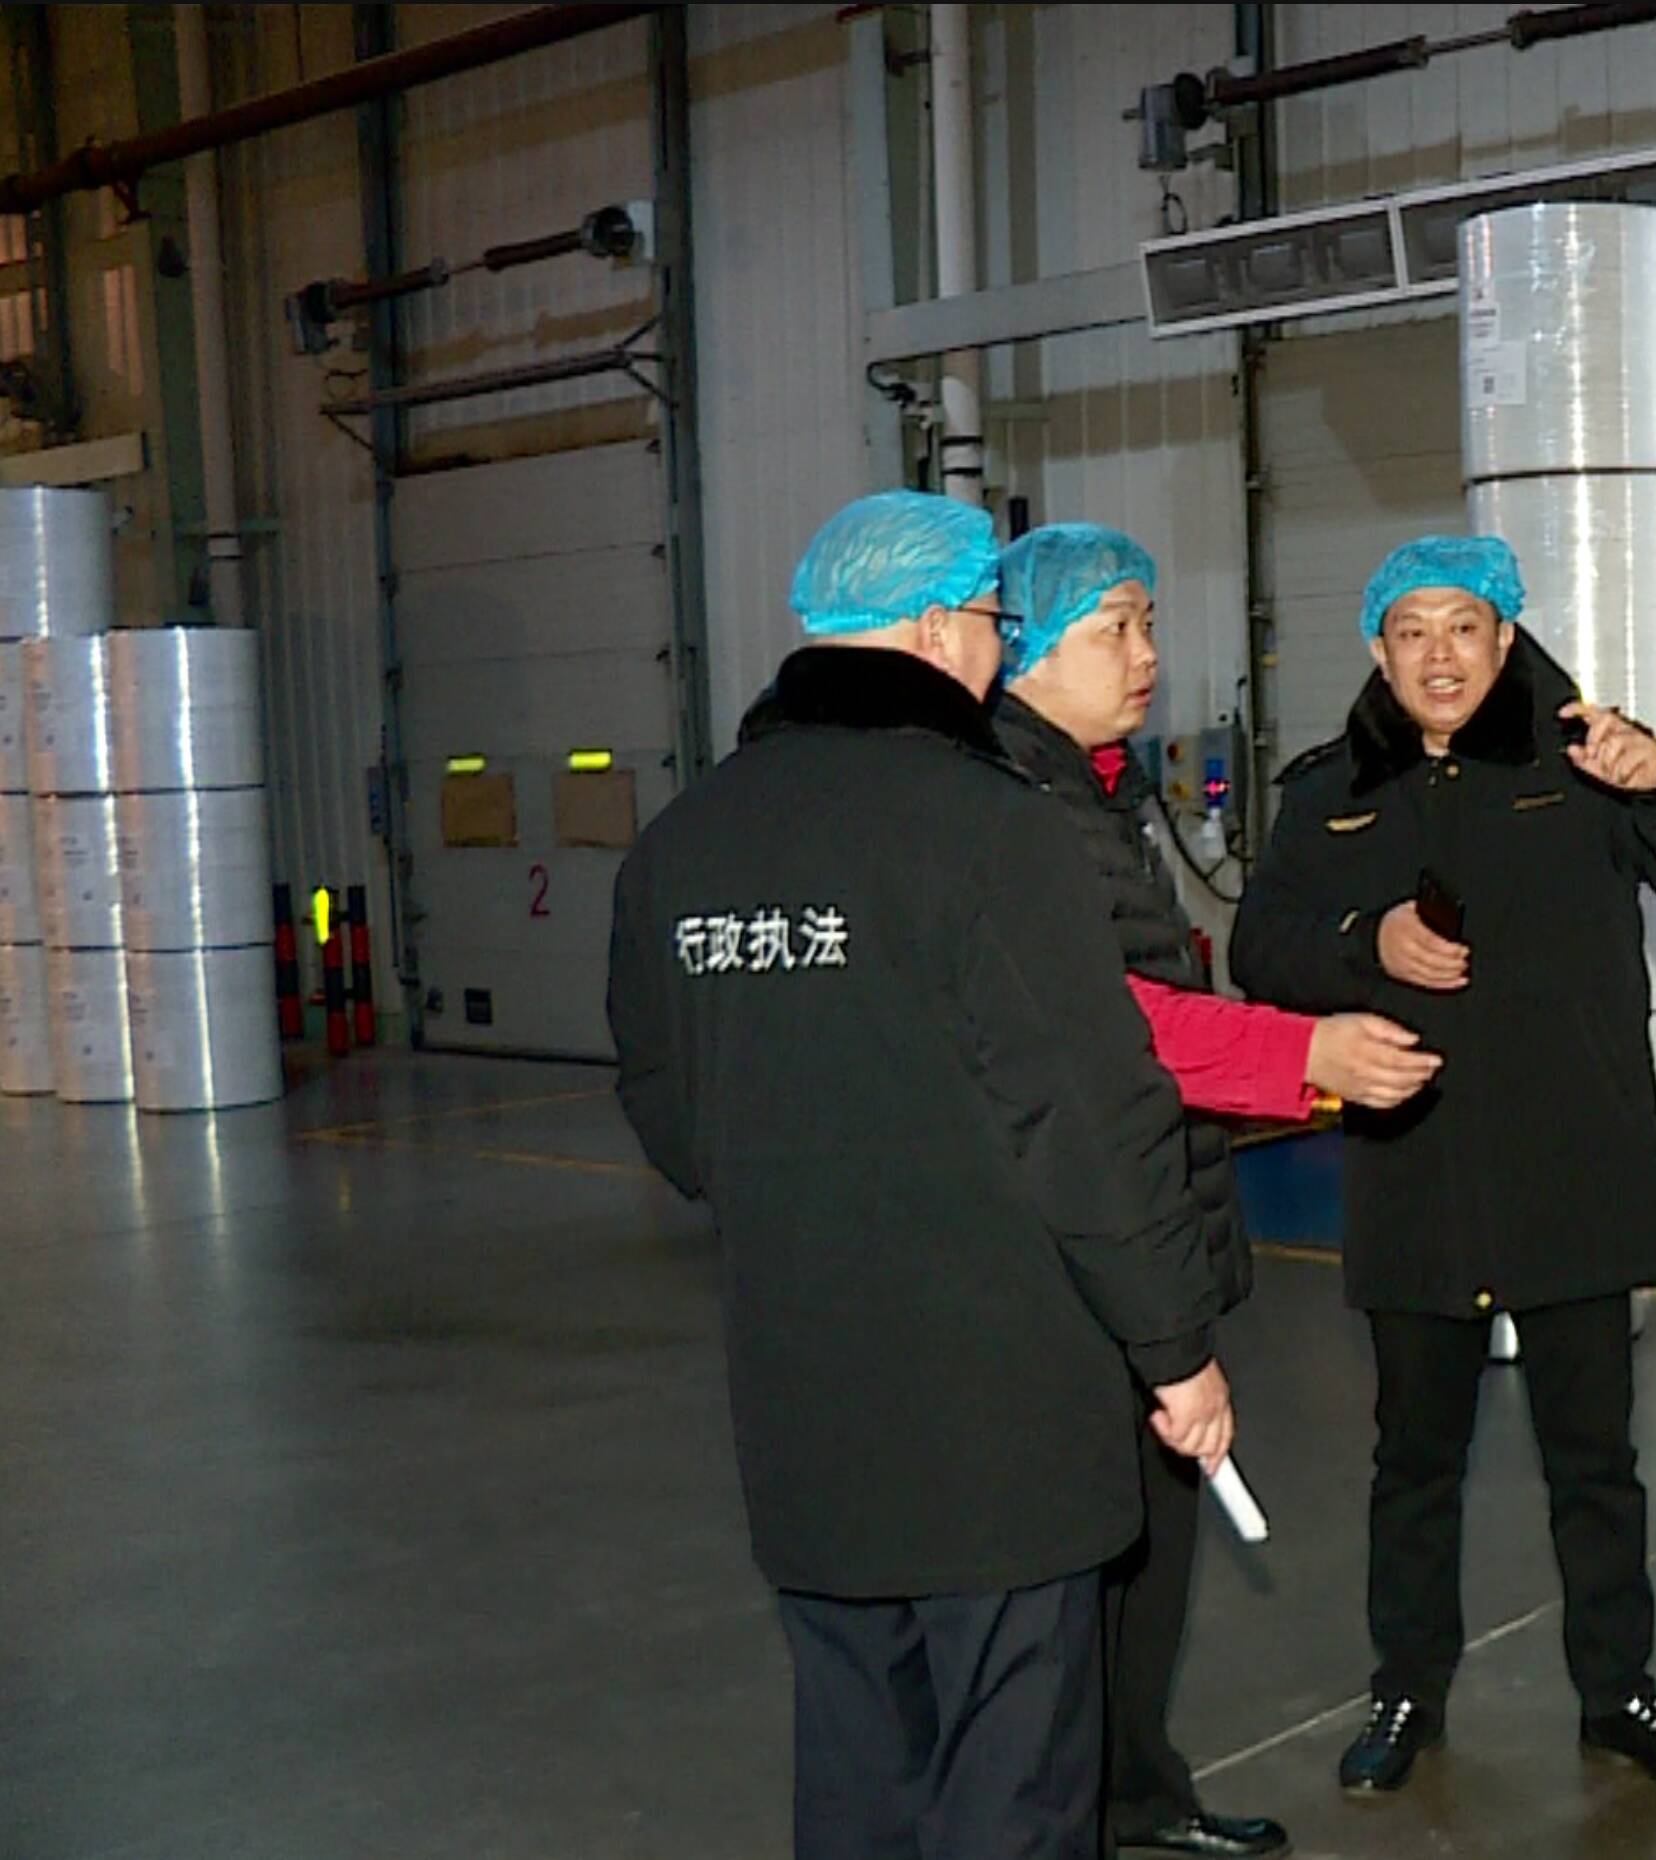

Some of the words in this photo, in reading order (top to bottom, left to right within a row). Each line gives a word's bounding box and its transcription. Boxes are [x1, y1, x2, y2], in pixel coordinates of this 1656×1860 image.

[528, 863, 551, 917] 2
[675, 905, 849, 975] 行政执法
